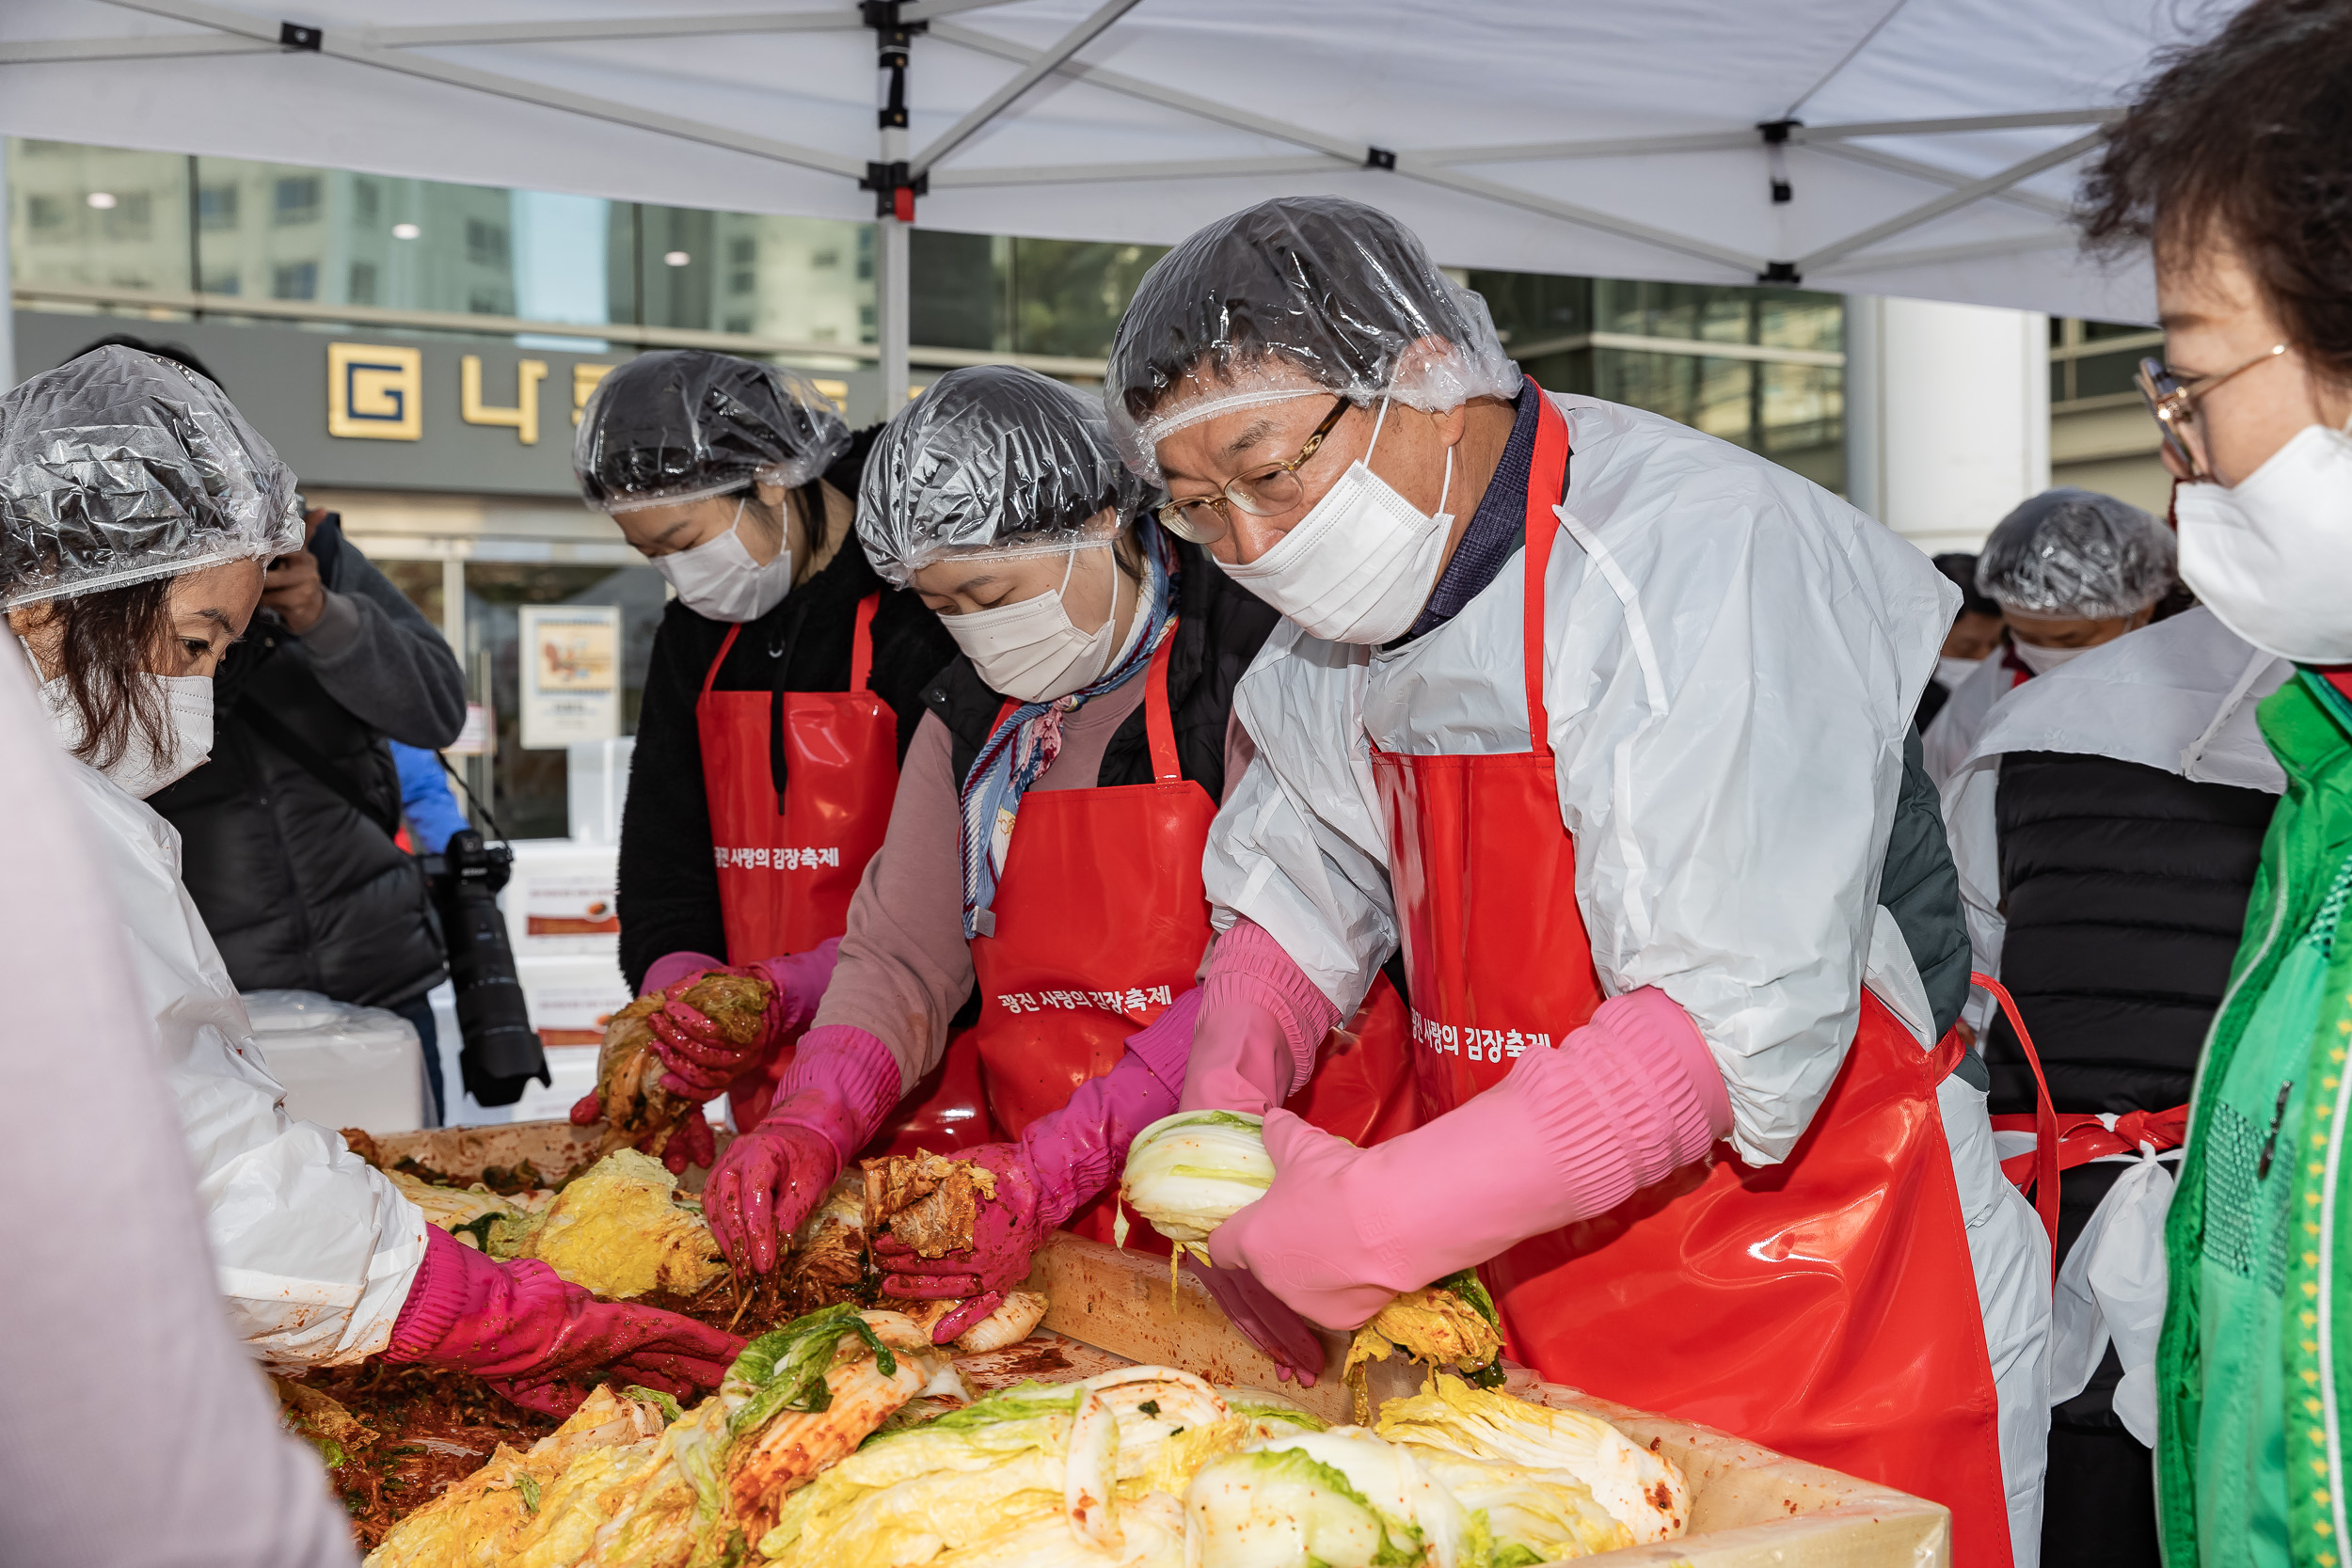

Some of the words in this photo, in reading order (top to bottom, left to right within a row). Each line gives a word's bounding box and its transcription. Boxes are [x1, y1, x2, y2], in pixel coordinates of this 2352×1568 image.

[730, 847, 770, 869] 사랑의
[772, 847, 839, 870] 김장축제
[997, 991, 1040, 1014] 광진
[1039, 990, 1093, 1010] 사랑의
[1088, 985, 1172, 1015] 김장축제
[1423, 1018, 1459, 1056] 사랑의
